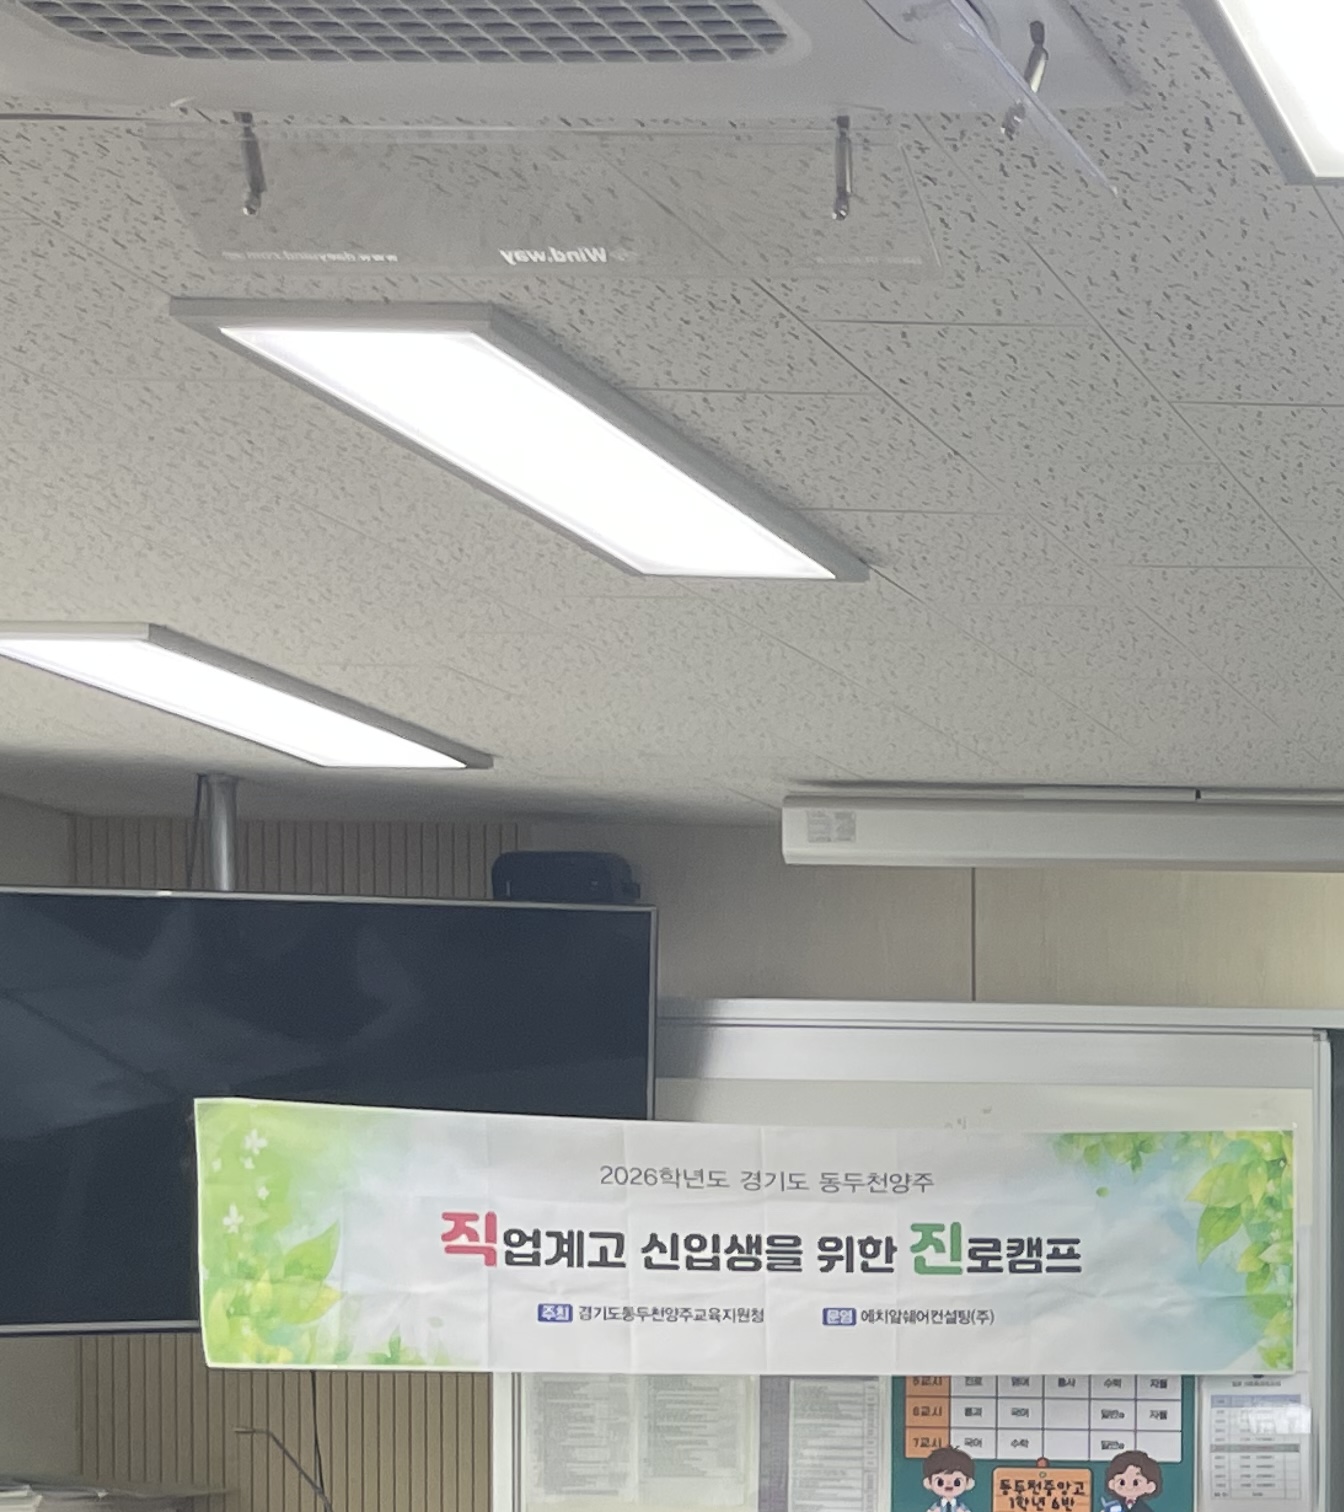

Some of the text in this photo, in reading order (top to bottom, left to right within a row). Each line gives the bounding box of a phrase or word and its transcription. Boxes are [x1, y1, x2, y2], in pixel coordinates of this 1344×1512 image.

[600, 1165, 934, 1194] 2026학년도 경기도 동두천양주
[440, 1211, 1082, 1276] 직업계고 신입생을 위한 진로캠프
[578, 1306, 764, 1324] 경기도동두천양주교육지원청
[1000, 1479, 1085, 1496] 동두천중앙고
